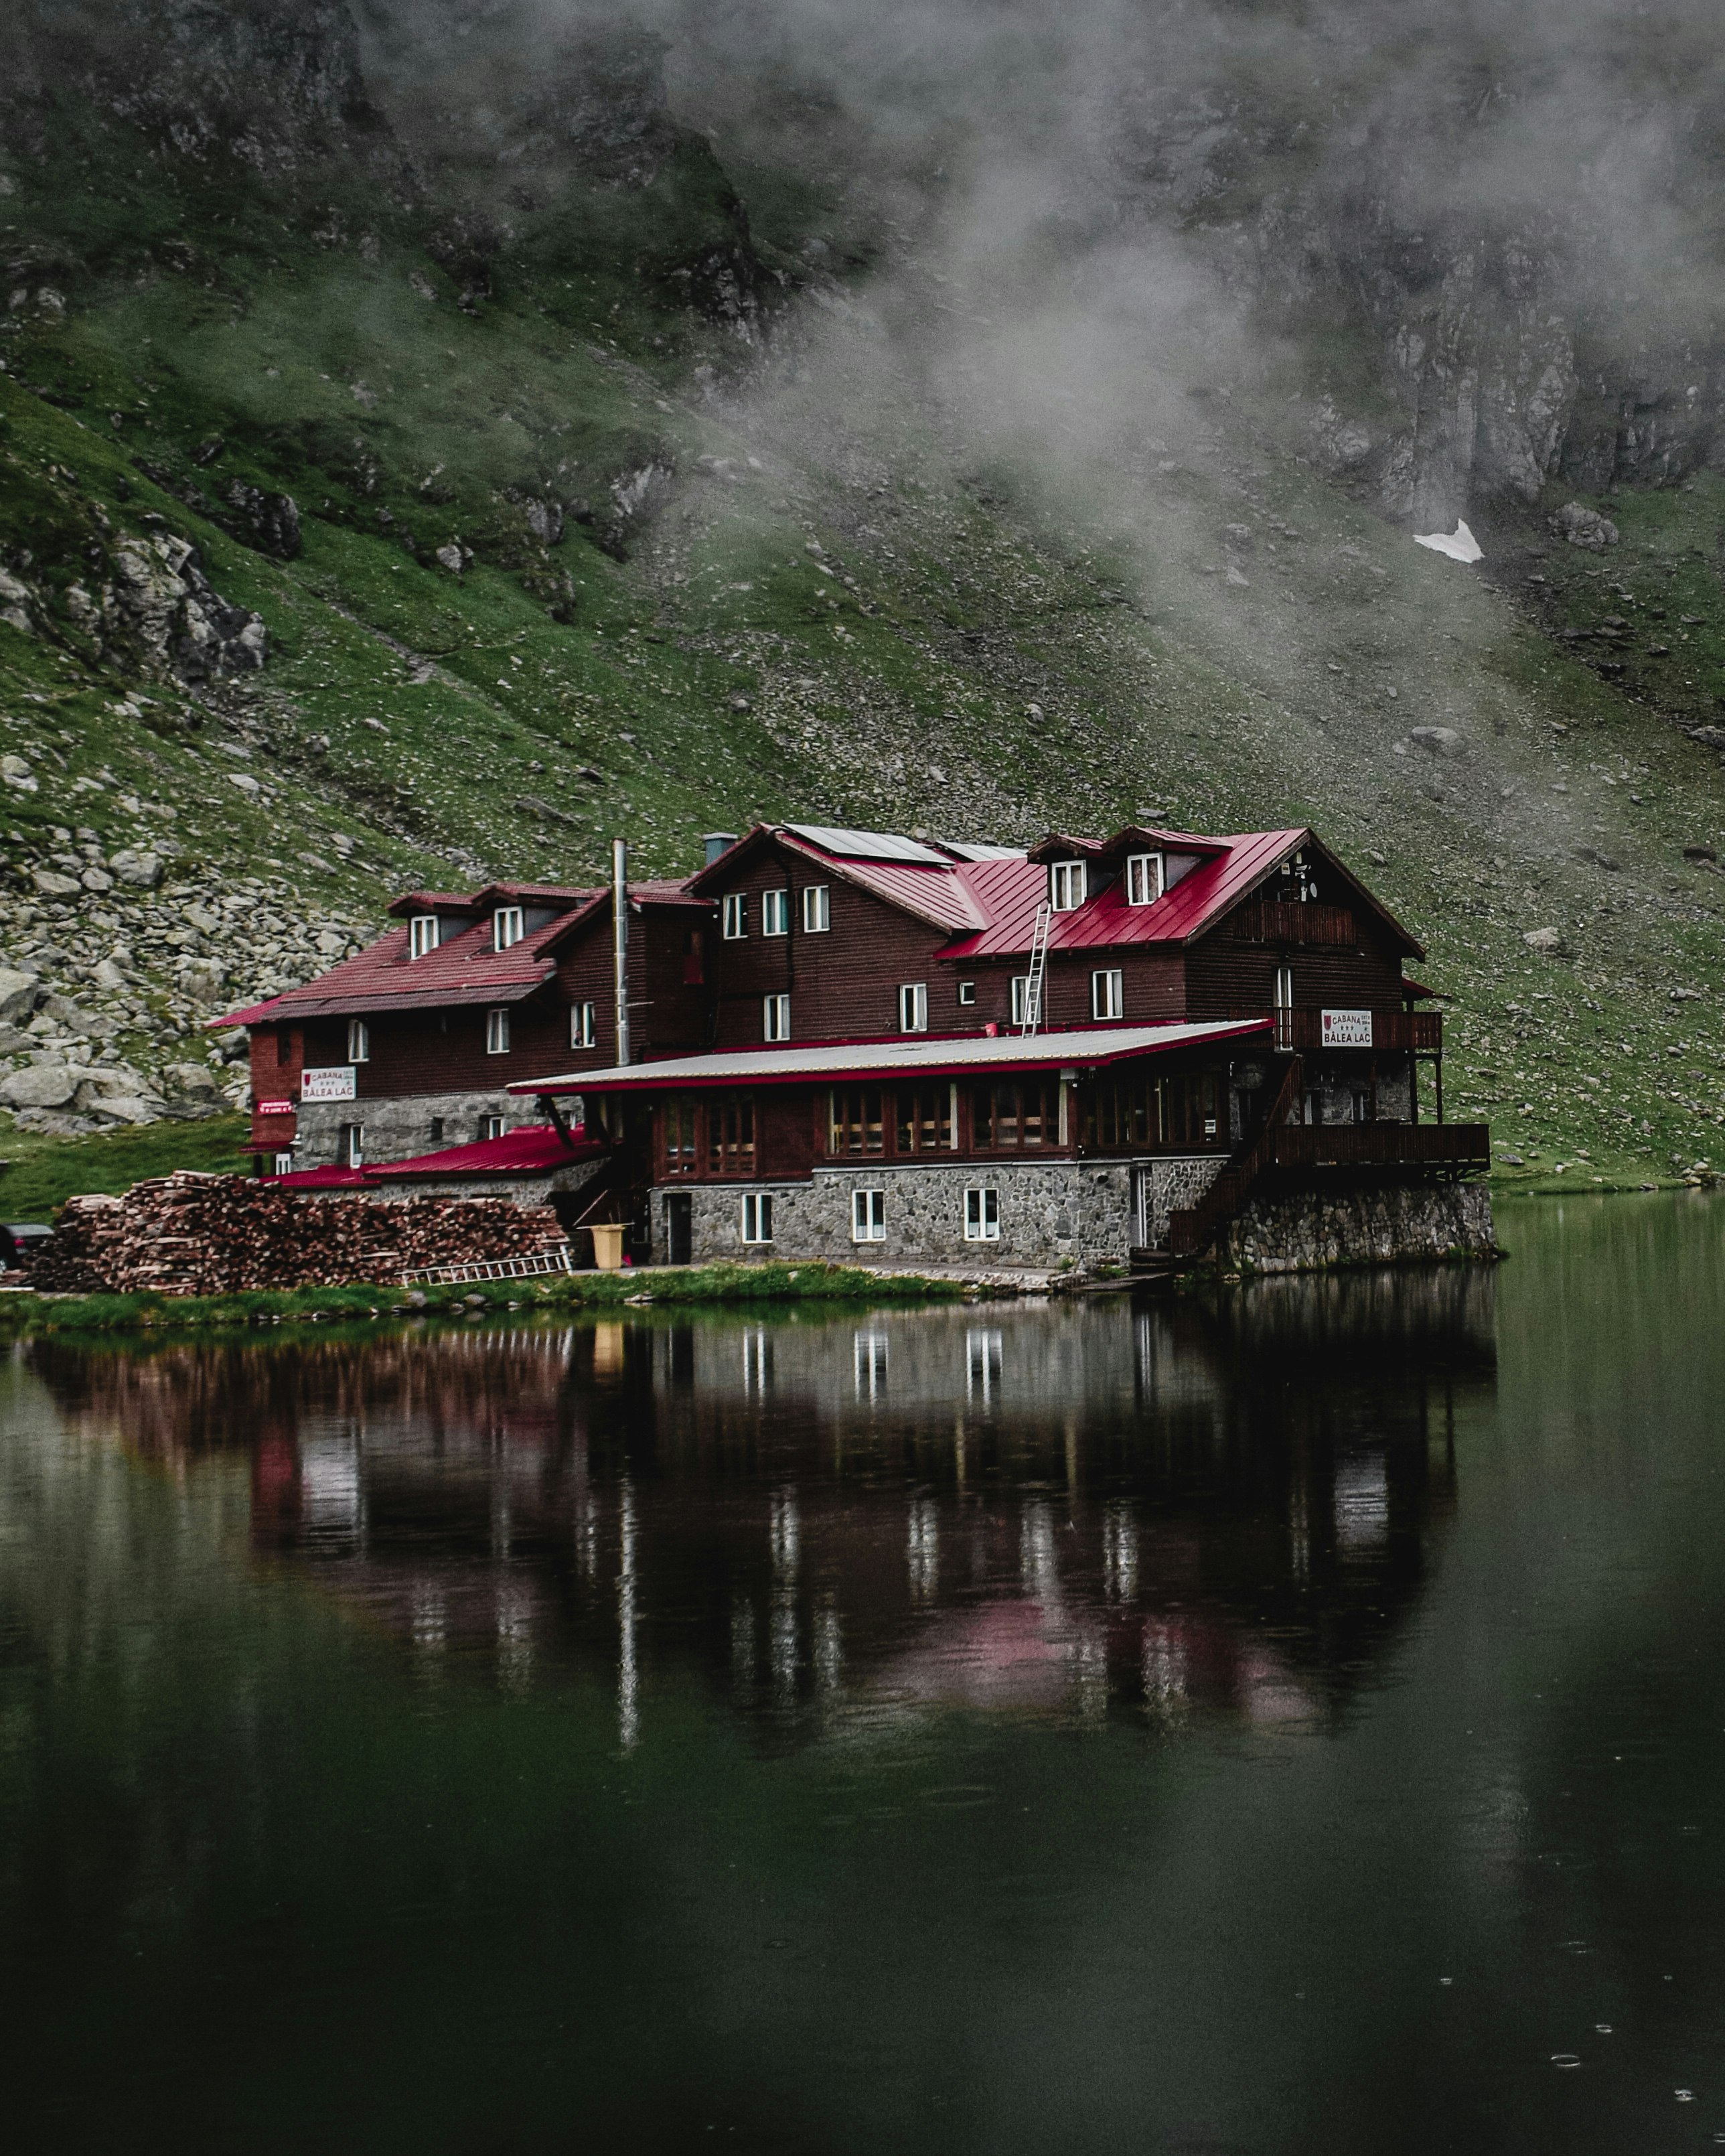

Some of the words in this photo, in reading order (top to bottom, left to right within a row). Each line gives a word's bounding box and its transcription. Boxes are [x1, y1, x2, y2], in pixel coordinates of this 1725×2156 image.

[1333, 1015, 1361, 1025] CABANA
[1355, 1033, 1370, 1043] LAC
[312, 1072, 342, 1081] CABANA
[335, 1086, 353, 1096] LAC
